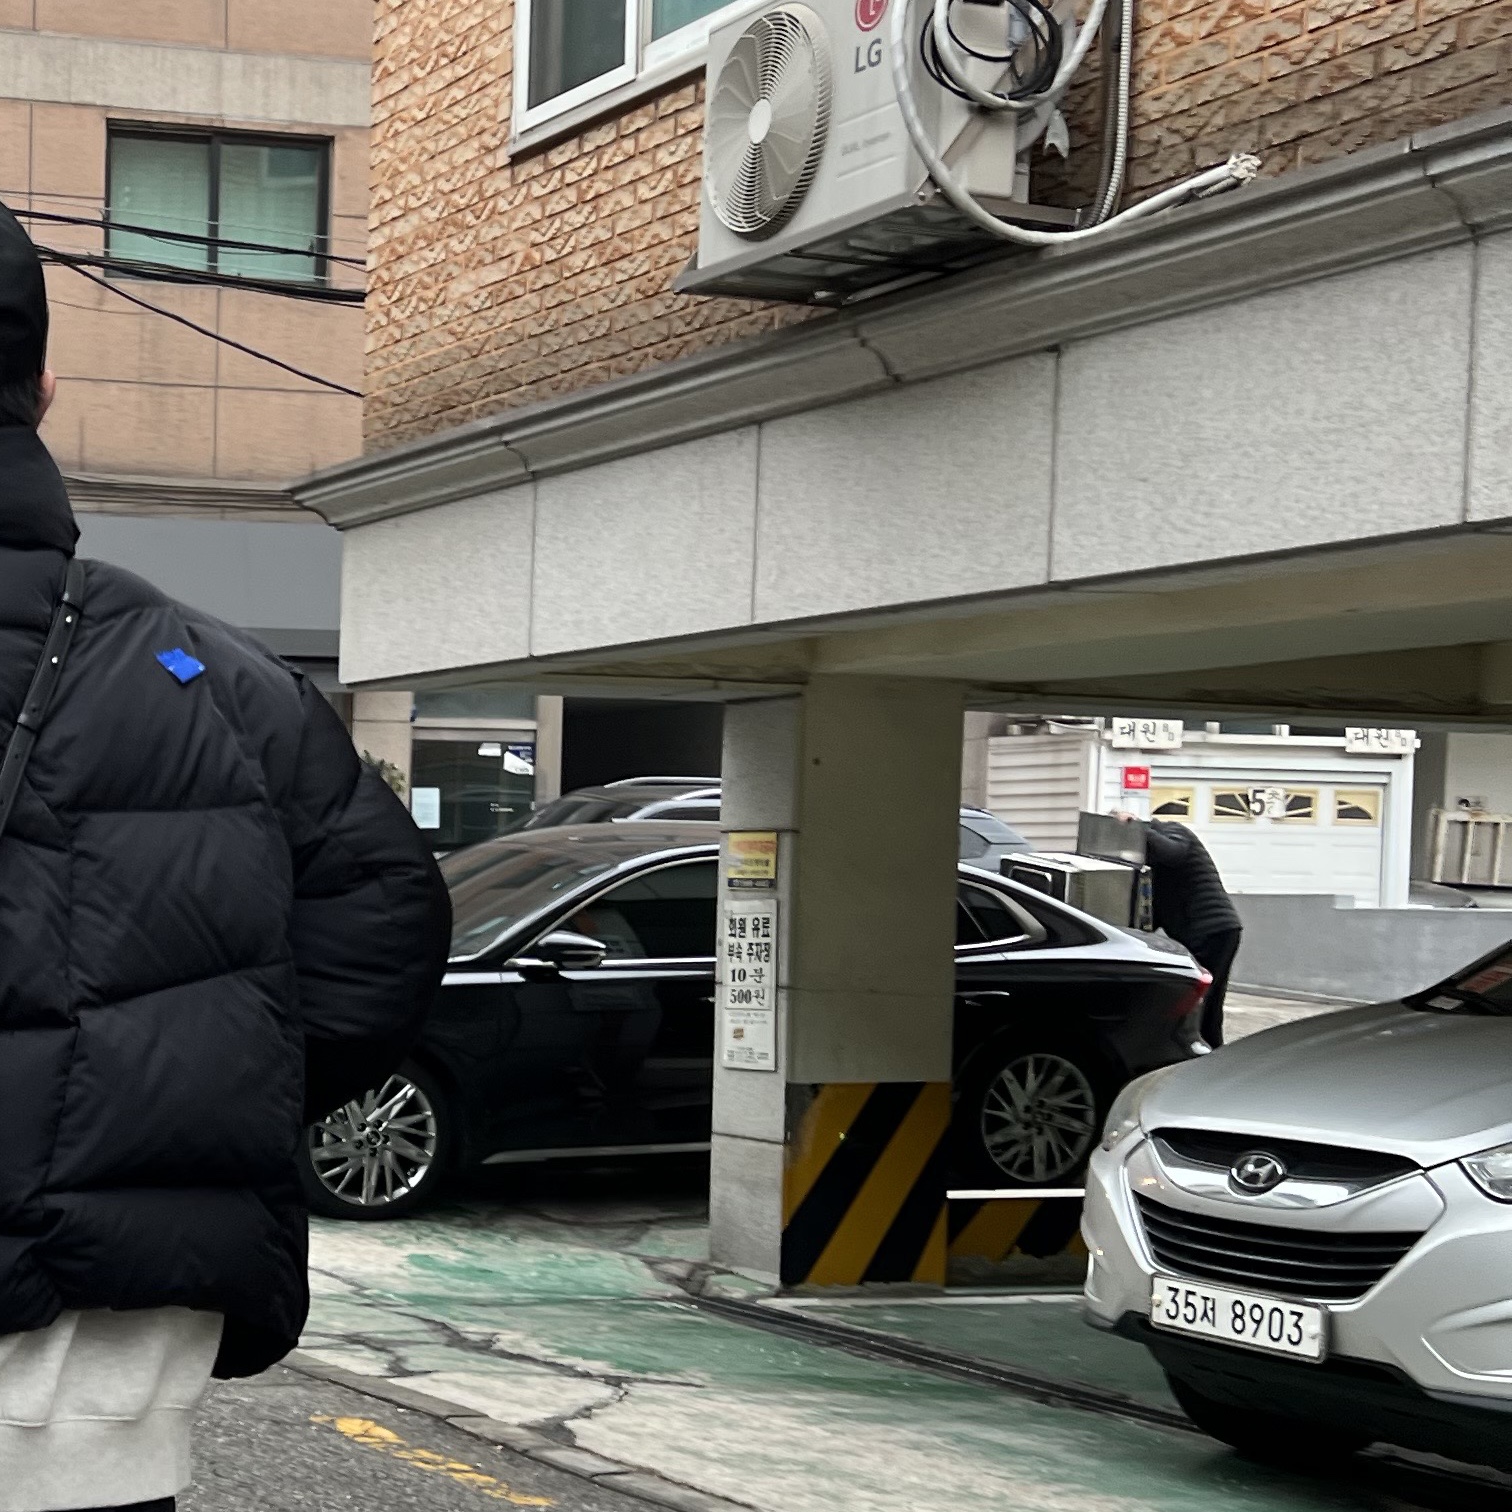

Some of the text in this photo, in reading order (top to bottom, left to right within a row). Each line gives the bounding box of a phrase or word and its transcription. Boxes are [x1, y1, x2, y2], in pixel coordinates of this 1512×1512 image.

[854, 38, 882, 74] LG
[751, 917, 771, 938] 유료
[746, 942, 771, 963] 주차장
[729, 988, 765, 1006] 500원
[1165, 1285, 1304, 1346] 35저 8903
